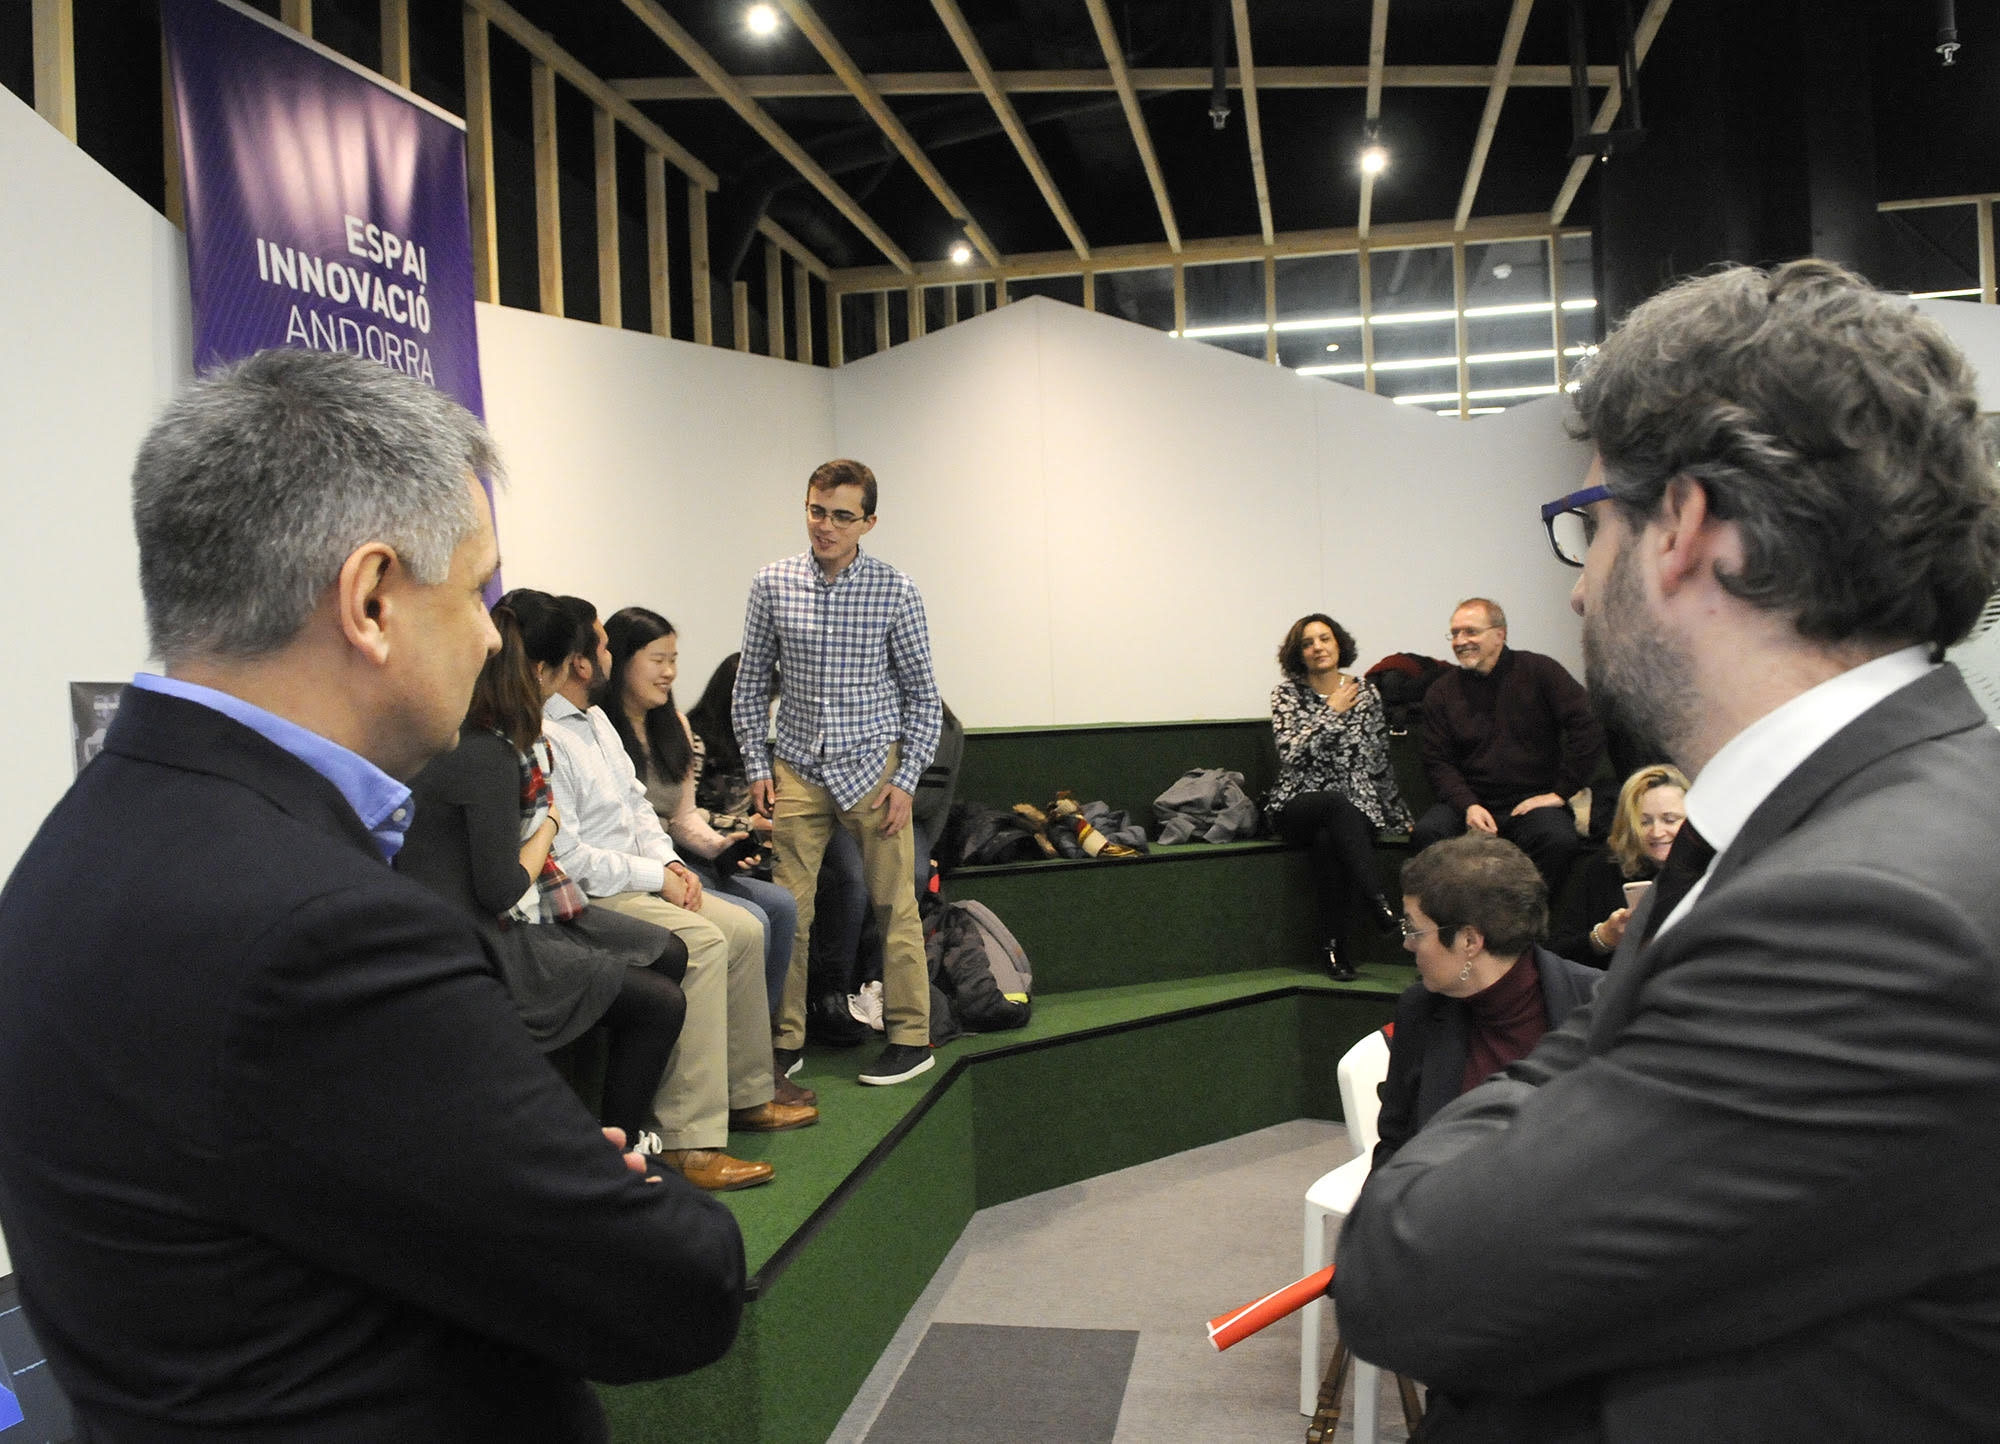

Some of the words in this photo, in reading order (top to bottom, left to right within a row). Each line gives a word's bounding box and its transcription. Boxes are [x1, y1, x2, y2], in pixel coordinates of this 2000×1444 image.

[257, 238, 431, 334] INNOVACIÓ
[345, 214, 427, 284] ESPAI
[286, 304, 435, 386] ANDORRA
